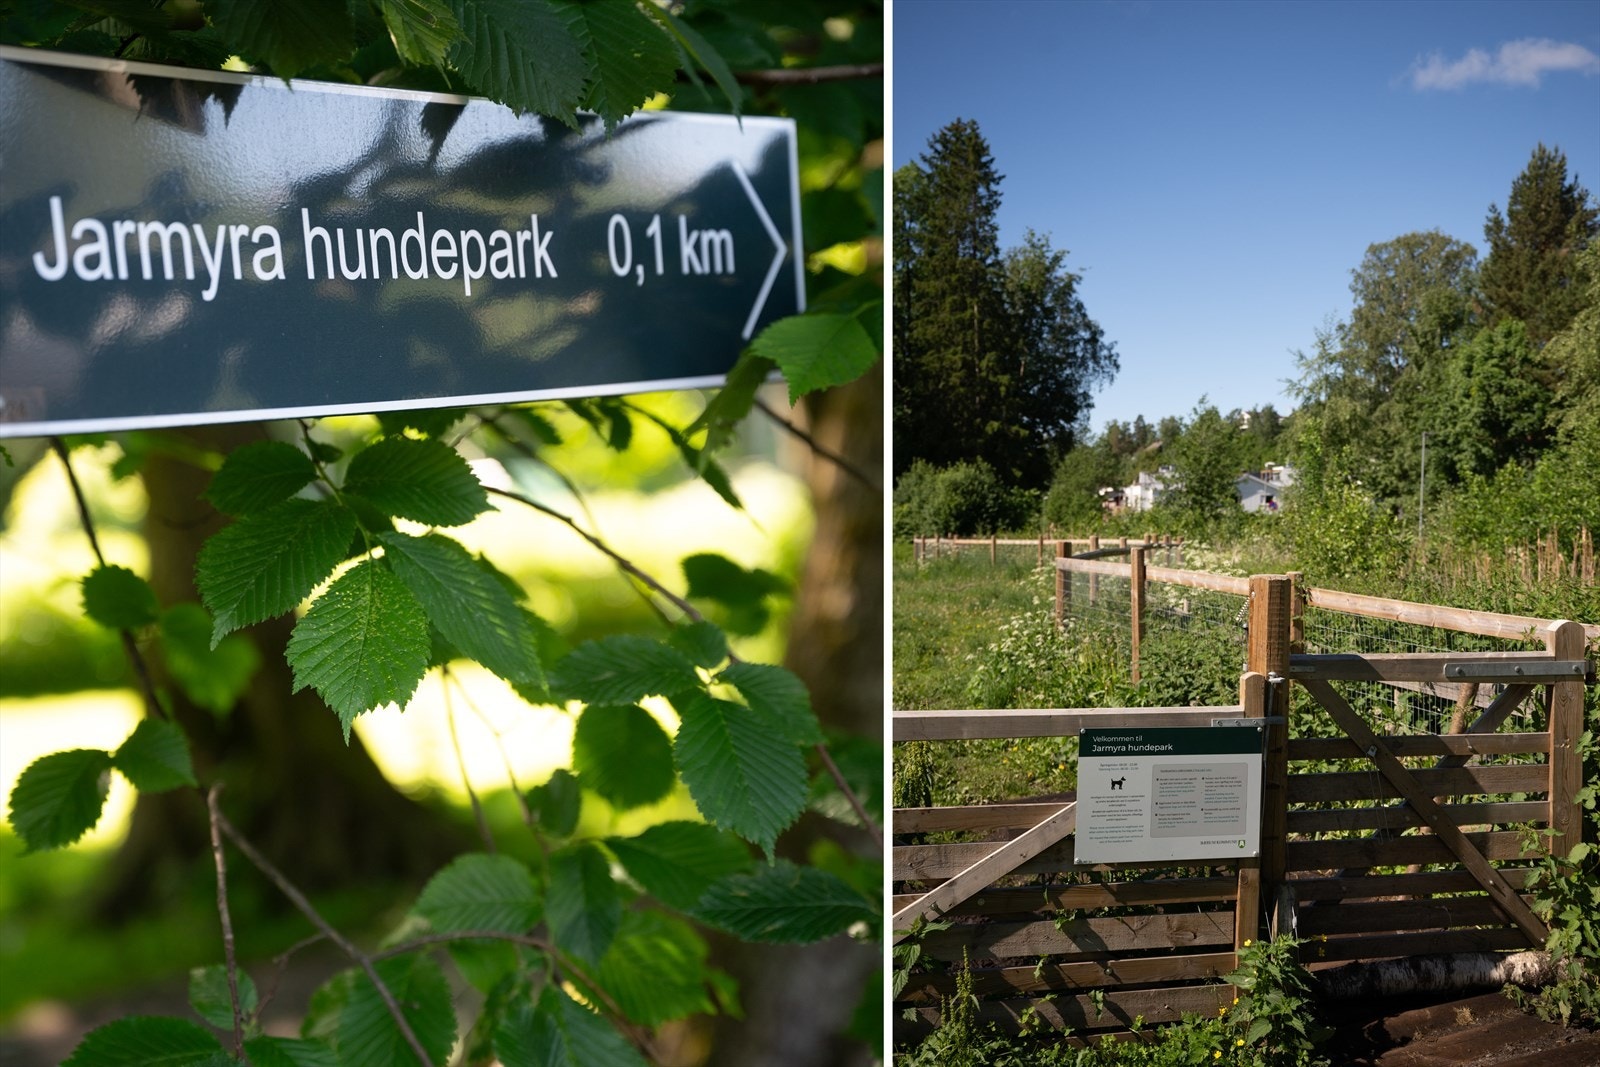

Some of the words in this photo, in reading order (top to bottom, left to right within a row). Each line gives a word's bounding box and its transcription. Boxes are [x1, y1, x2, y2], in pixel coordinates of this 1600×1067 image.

[33, 195, 286, 301] Jarmyra
[301, 208, 558, 297] hundepark
[608, 214, 664, 286] 0,1
[679, 214, 735, 275] km
[1092, 744, 1126, 753] Jarmyra
[1128, 743, 1173, 752] hundepark
